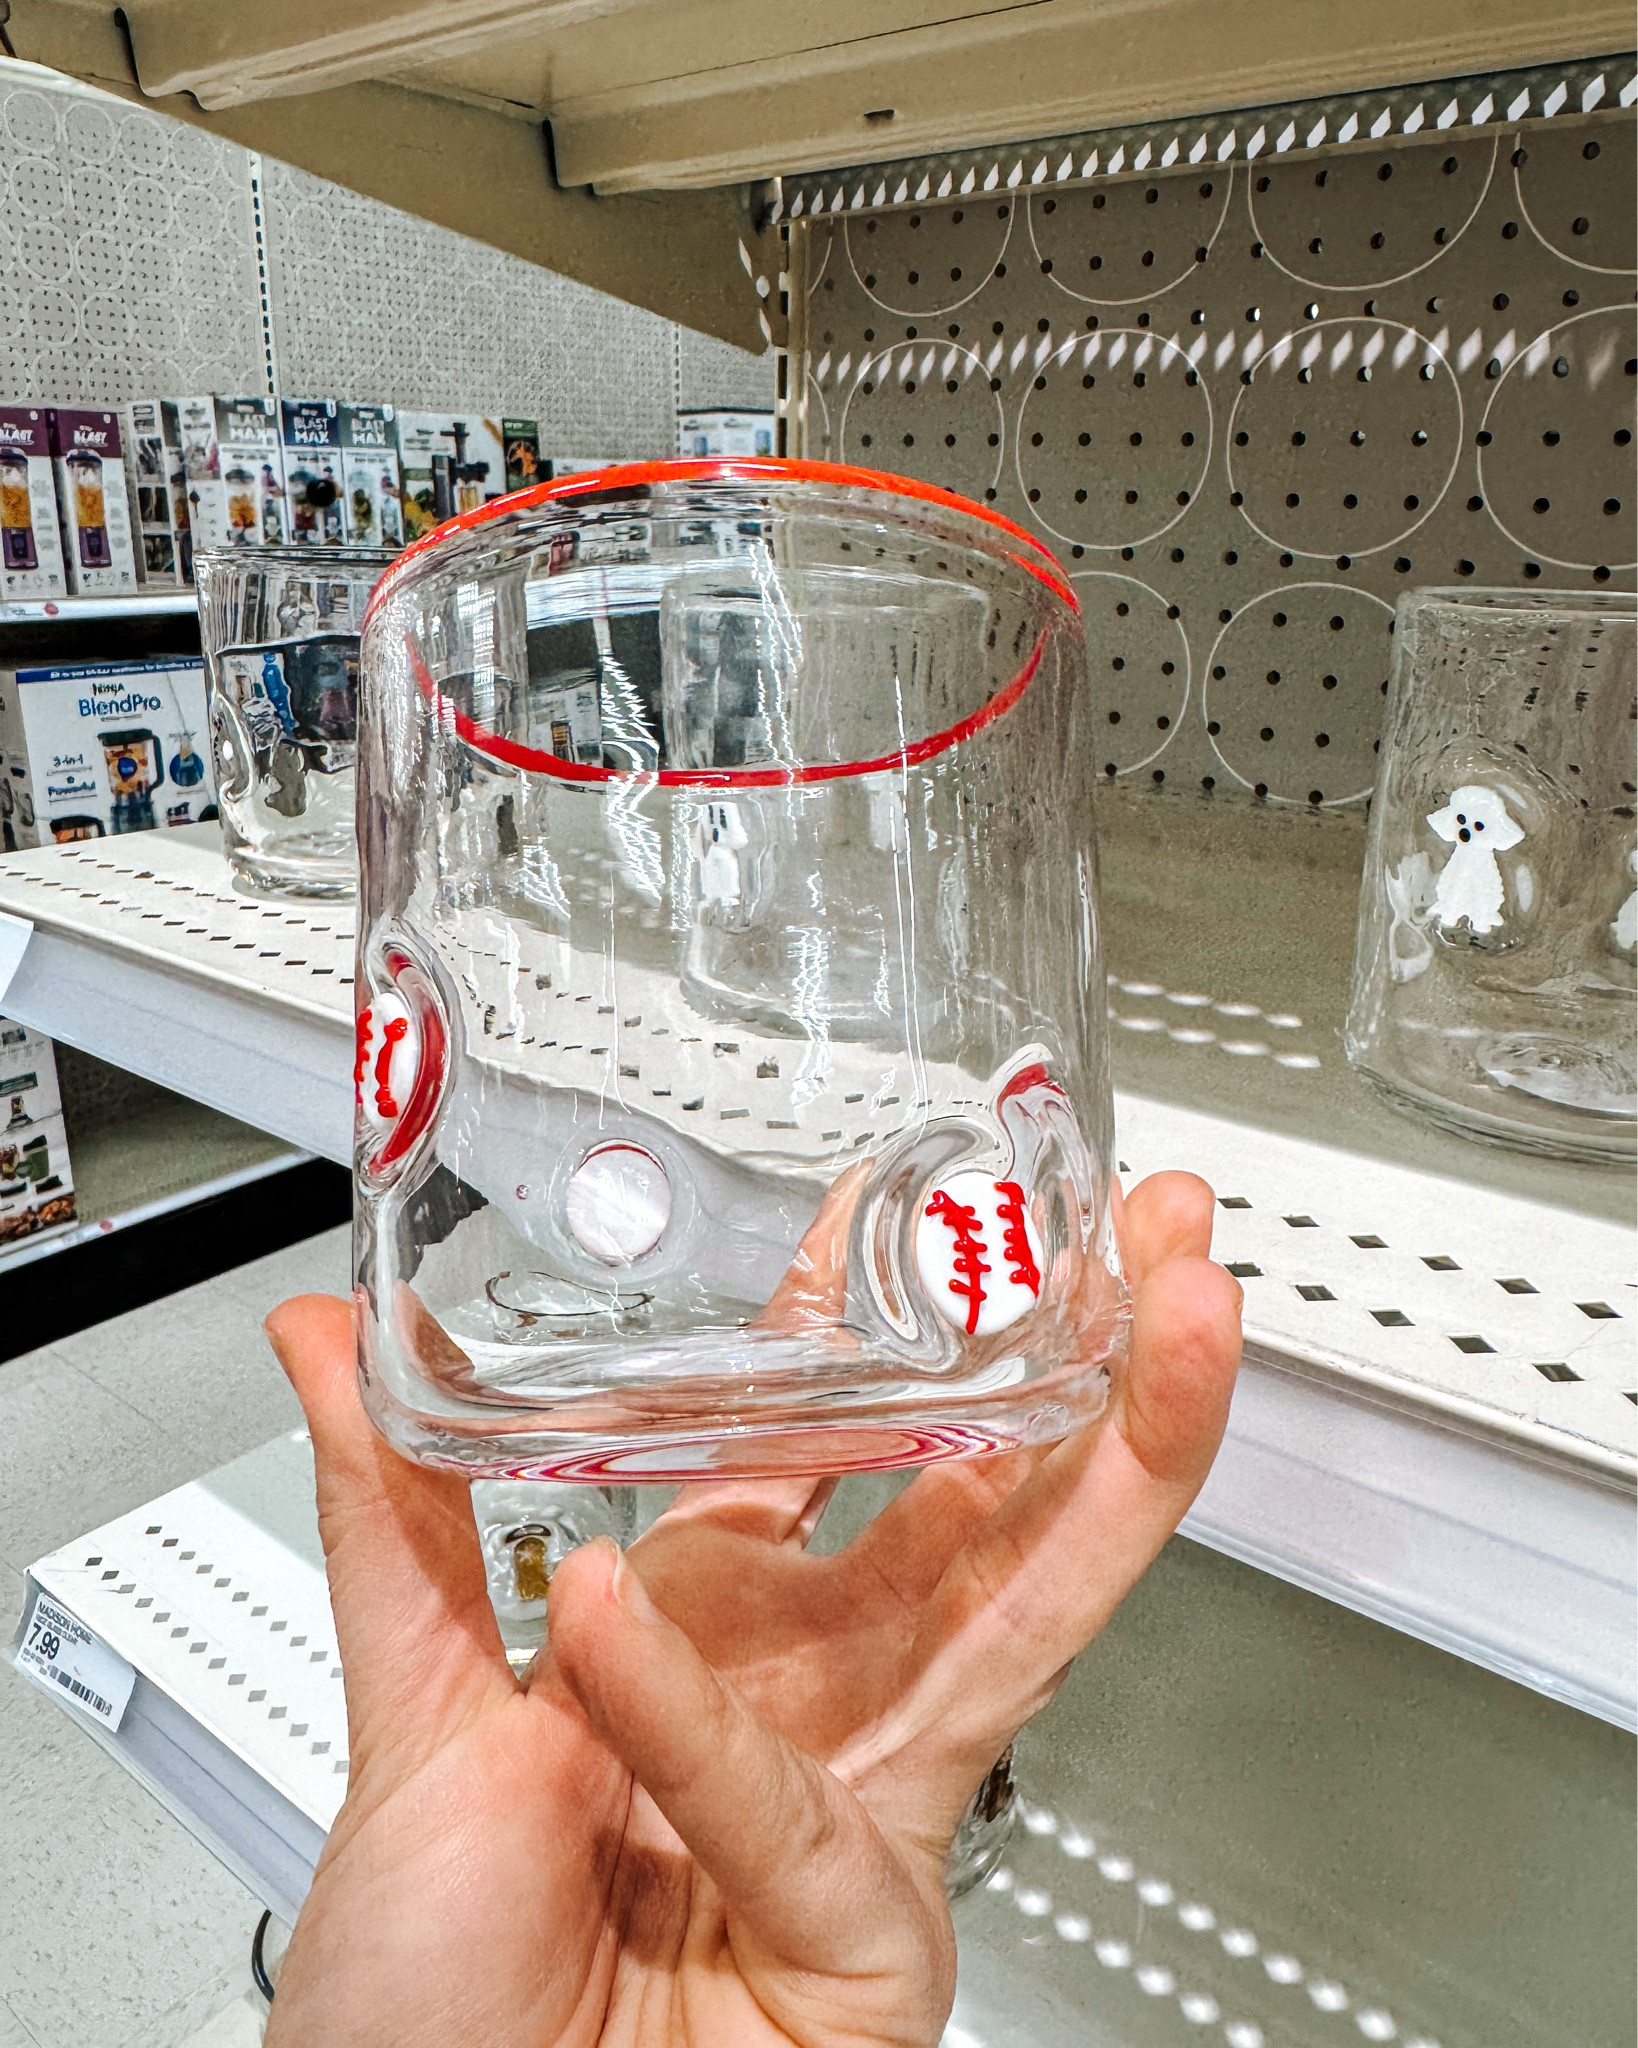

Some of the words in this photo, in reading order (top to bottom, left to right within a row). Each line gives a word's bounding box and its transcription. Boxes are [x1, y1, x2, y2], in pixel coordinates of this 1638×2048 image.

[293, 415, 328, 432] BLAST
[294, 430, 330, 444] MAX
[78, 693, 163, 717] BlendPro
[28, 1622, 60, 1660] 7.99
